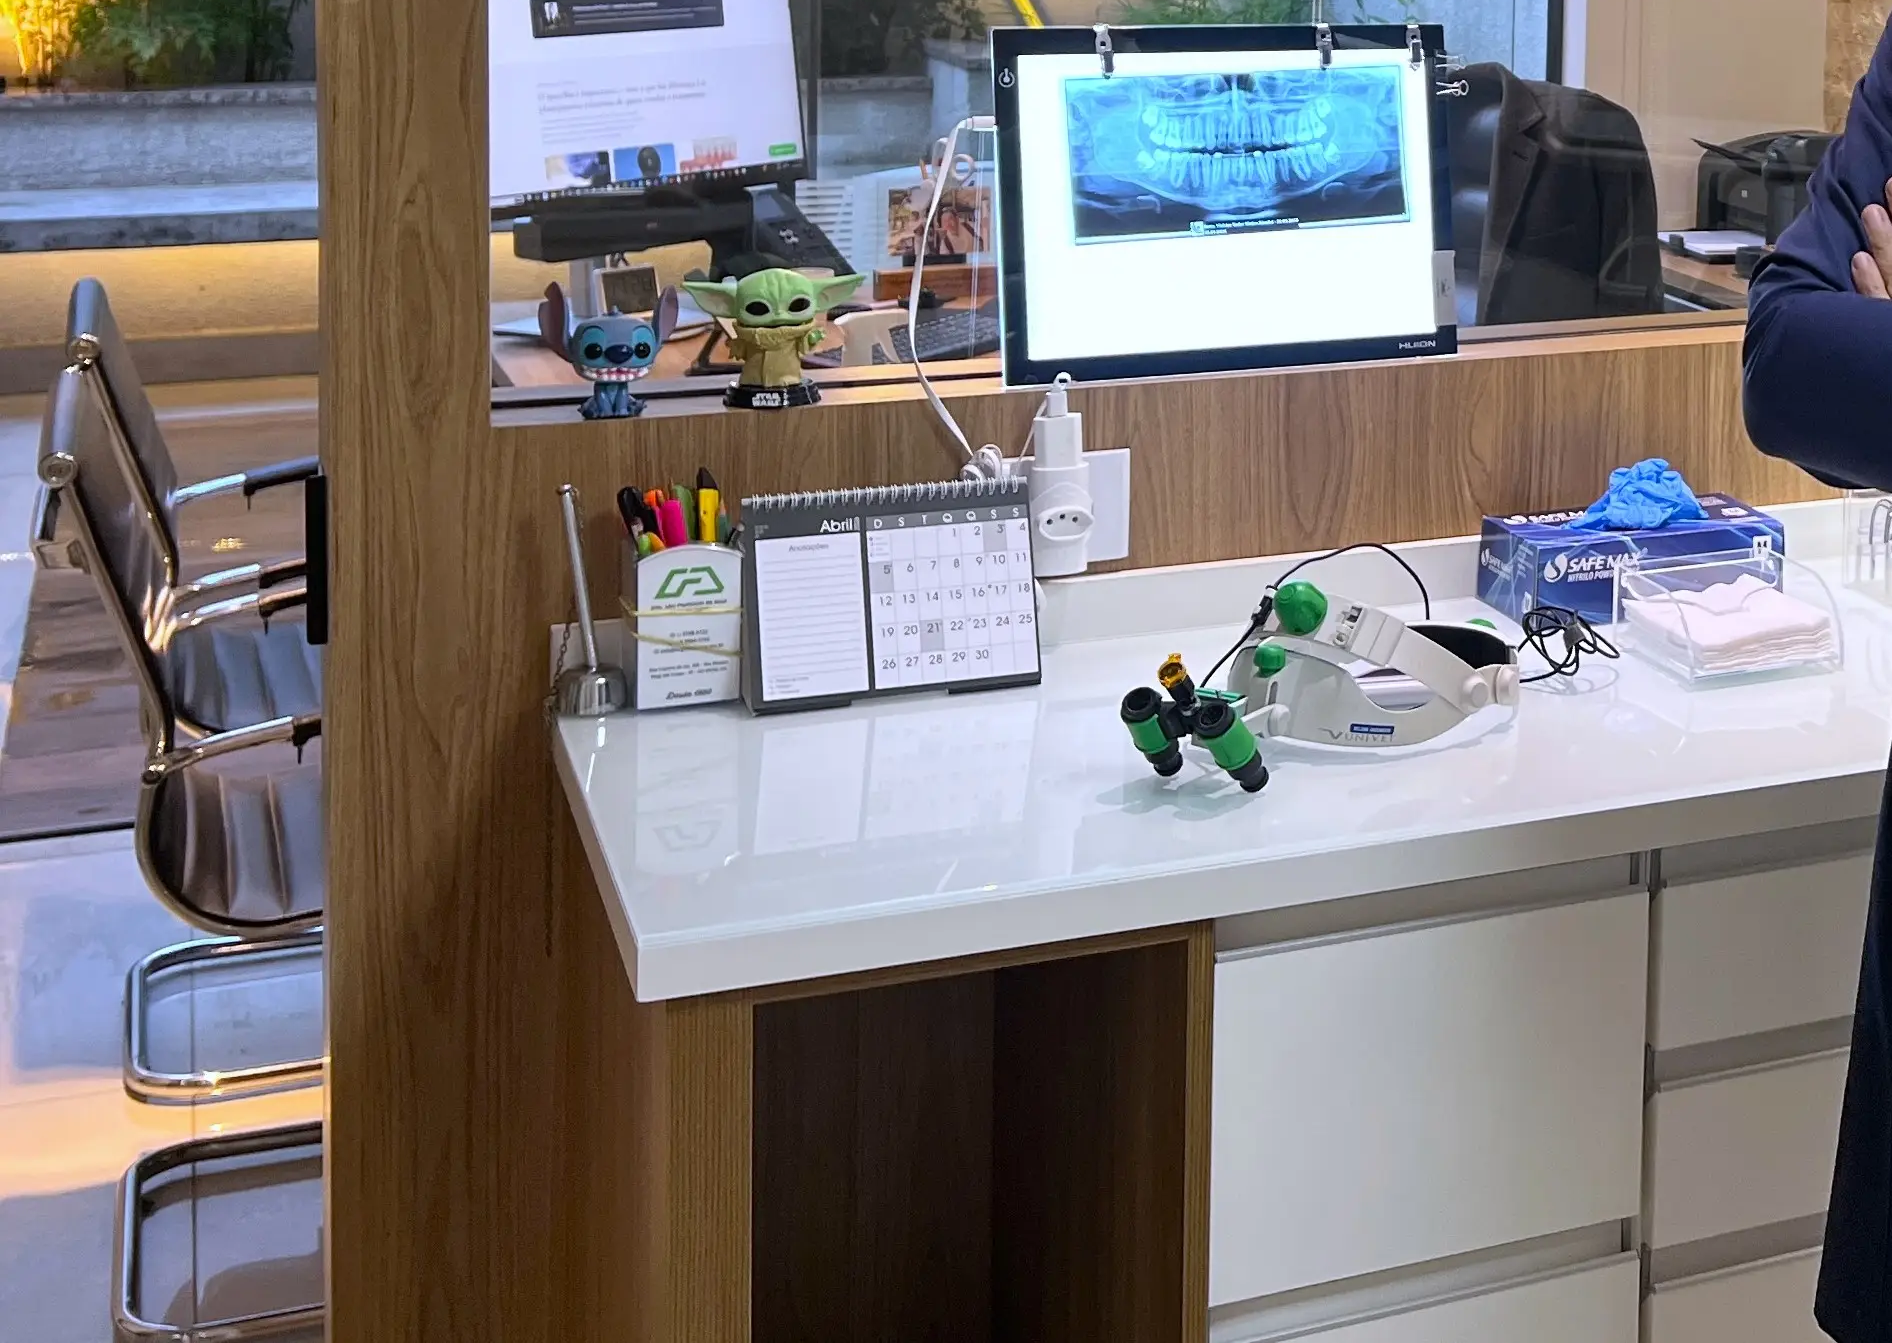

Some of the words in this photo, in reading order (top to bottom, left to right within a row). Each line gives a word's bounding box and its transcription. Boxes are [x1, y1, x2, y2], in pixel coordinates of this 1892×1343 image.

[820, 518, 853, 533] Abril
[874, 519, 882, 529] D
[898, 517, 905, 527] S
[922, 515, 927, 525] T
[943, 513, 953, 523] Q
[966, 511, 976, 521] Q
[990, 509, 997, 519] S
[1013, 507, 1019, 517] S
[974, 526, 981, 535] 2
[997, 524, 1003, 533] 3
[1019, 522, 1026, 531] 4
[883, 565, 890, 574] 5
[907, 563, 914, 573] 6
[930, 561, 937, 570] 7
[953, 558, 960, 568] 8
[976, 556, 983, 566] 9
[992, 554, 1006, 564] 10
[1015, 552, 1027, 562] 11
[1567, 555, 1606, 573] SAFE
[1607, 553, 1640, 569] MAX
[1567, 571, 1594, 583] NITRILO
[880, 595, 892, 606] 12
[902, 594, 916, 604] 13
[926, 591, 939, 602] 14
[950, 589, 962, 600] 15
[972, 587, 985, 598] 16
[995, 585, 1007, 595] 17
[1018, 582, 1030, 593] 18
[882, 627, 895, 638] 19
[904, 625, 918, 636] 20
[927, 623, 940, 633] 21
[950, 620, 964, 631] 22
[973, 618, 987, 629] 23
[995, 616, 1010, 626] 24
[1018, 614, 1032, 624] 25
[882, 659, 896, 670] 26
[905, 657, 919, 667] 27
[929, 654, 943, 665] 28
[952, 651, 966, 662] 29
[975, 649, 989, 659] 30
